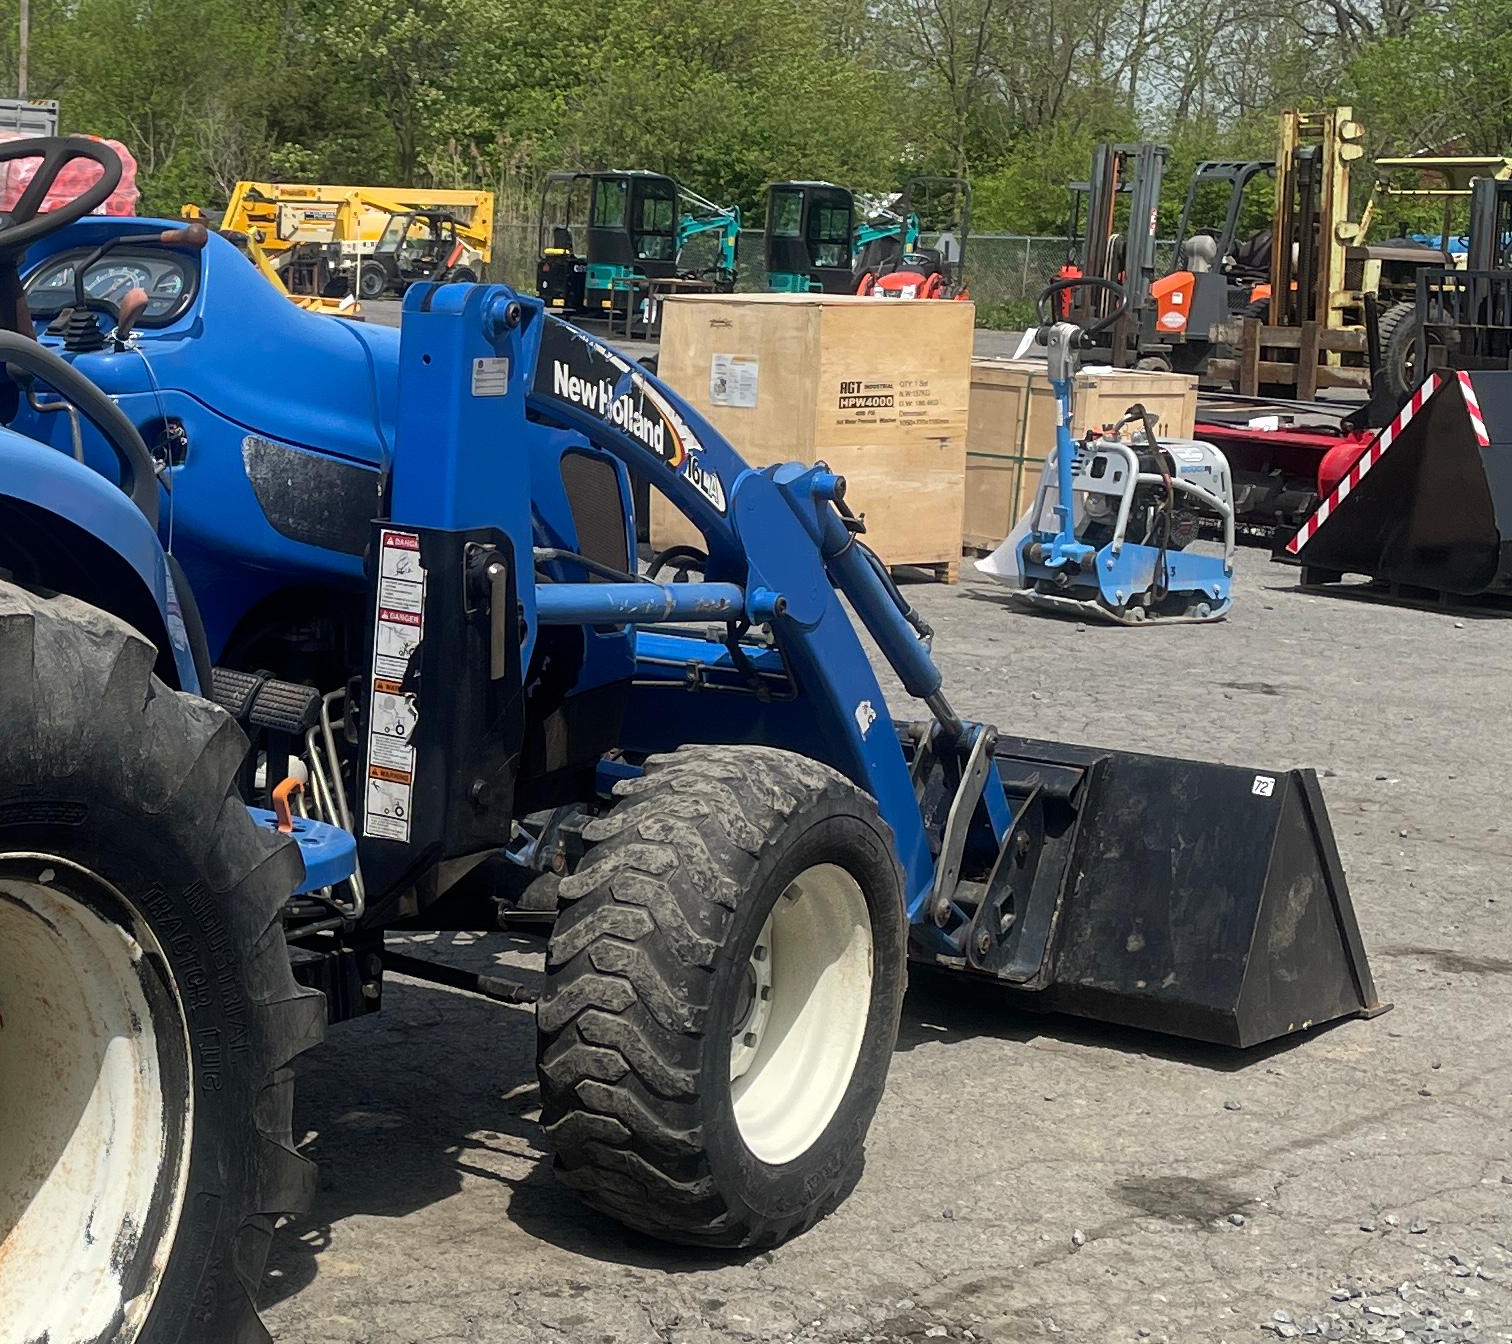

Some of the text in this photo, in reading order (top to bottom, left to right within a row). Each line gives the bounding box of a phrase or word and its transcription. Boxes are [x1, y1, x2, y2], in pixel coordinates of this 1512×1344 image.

[554, 360, 597, 409] New
[599, 378, 664, 455] Holland
[840, 396, 893, 407] HPW4000
[389, 612, 419, 625] DANGER
[141, 880, 213, 1011] TRACTOR
[183, 878, 252, 1054] INDUSTRIAL
